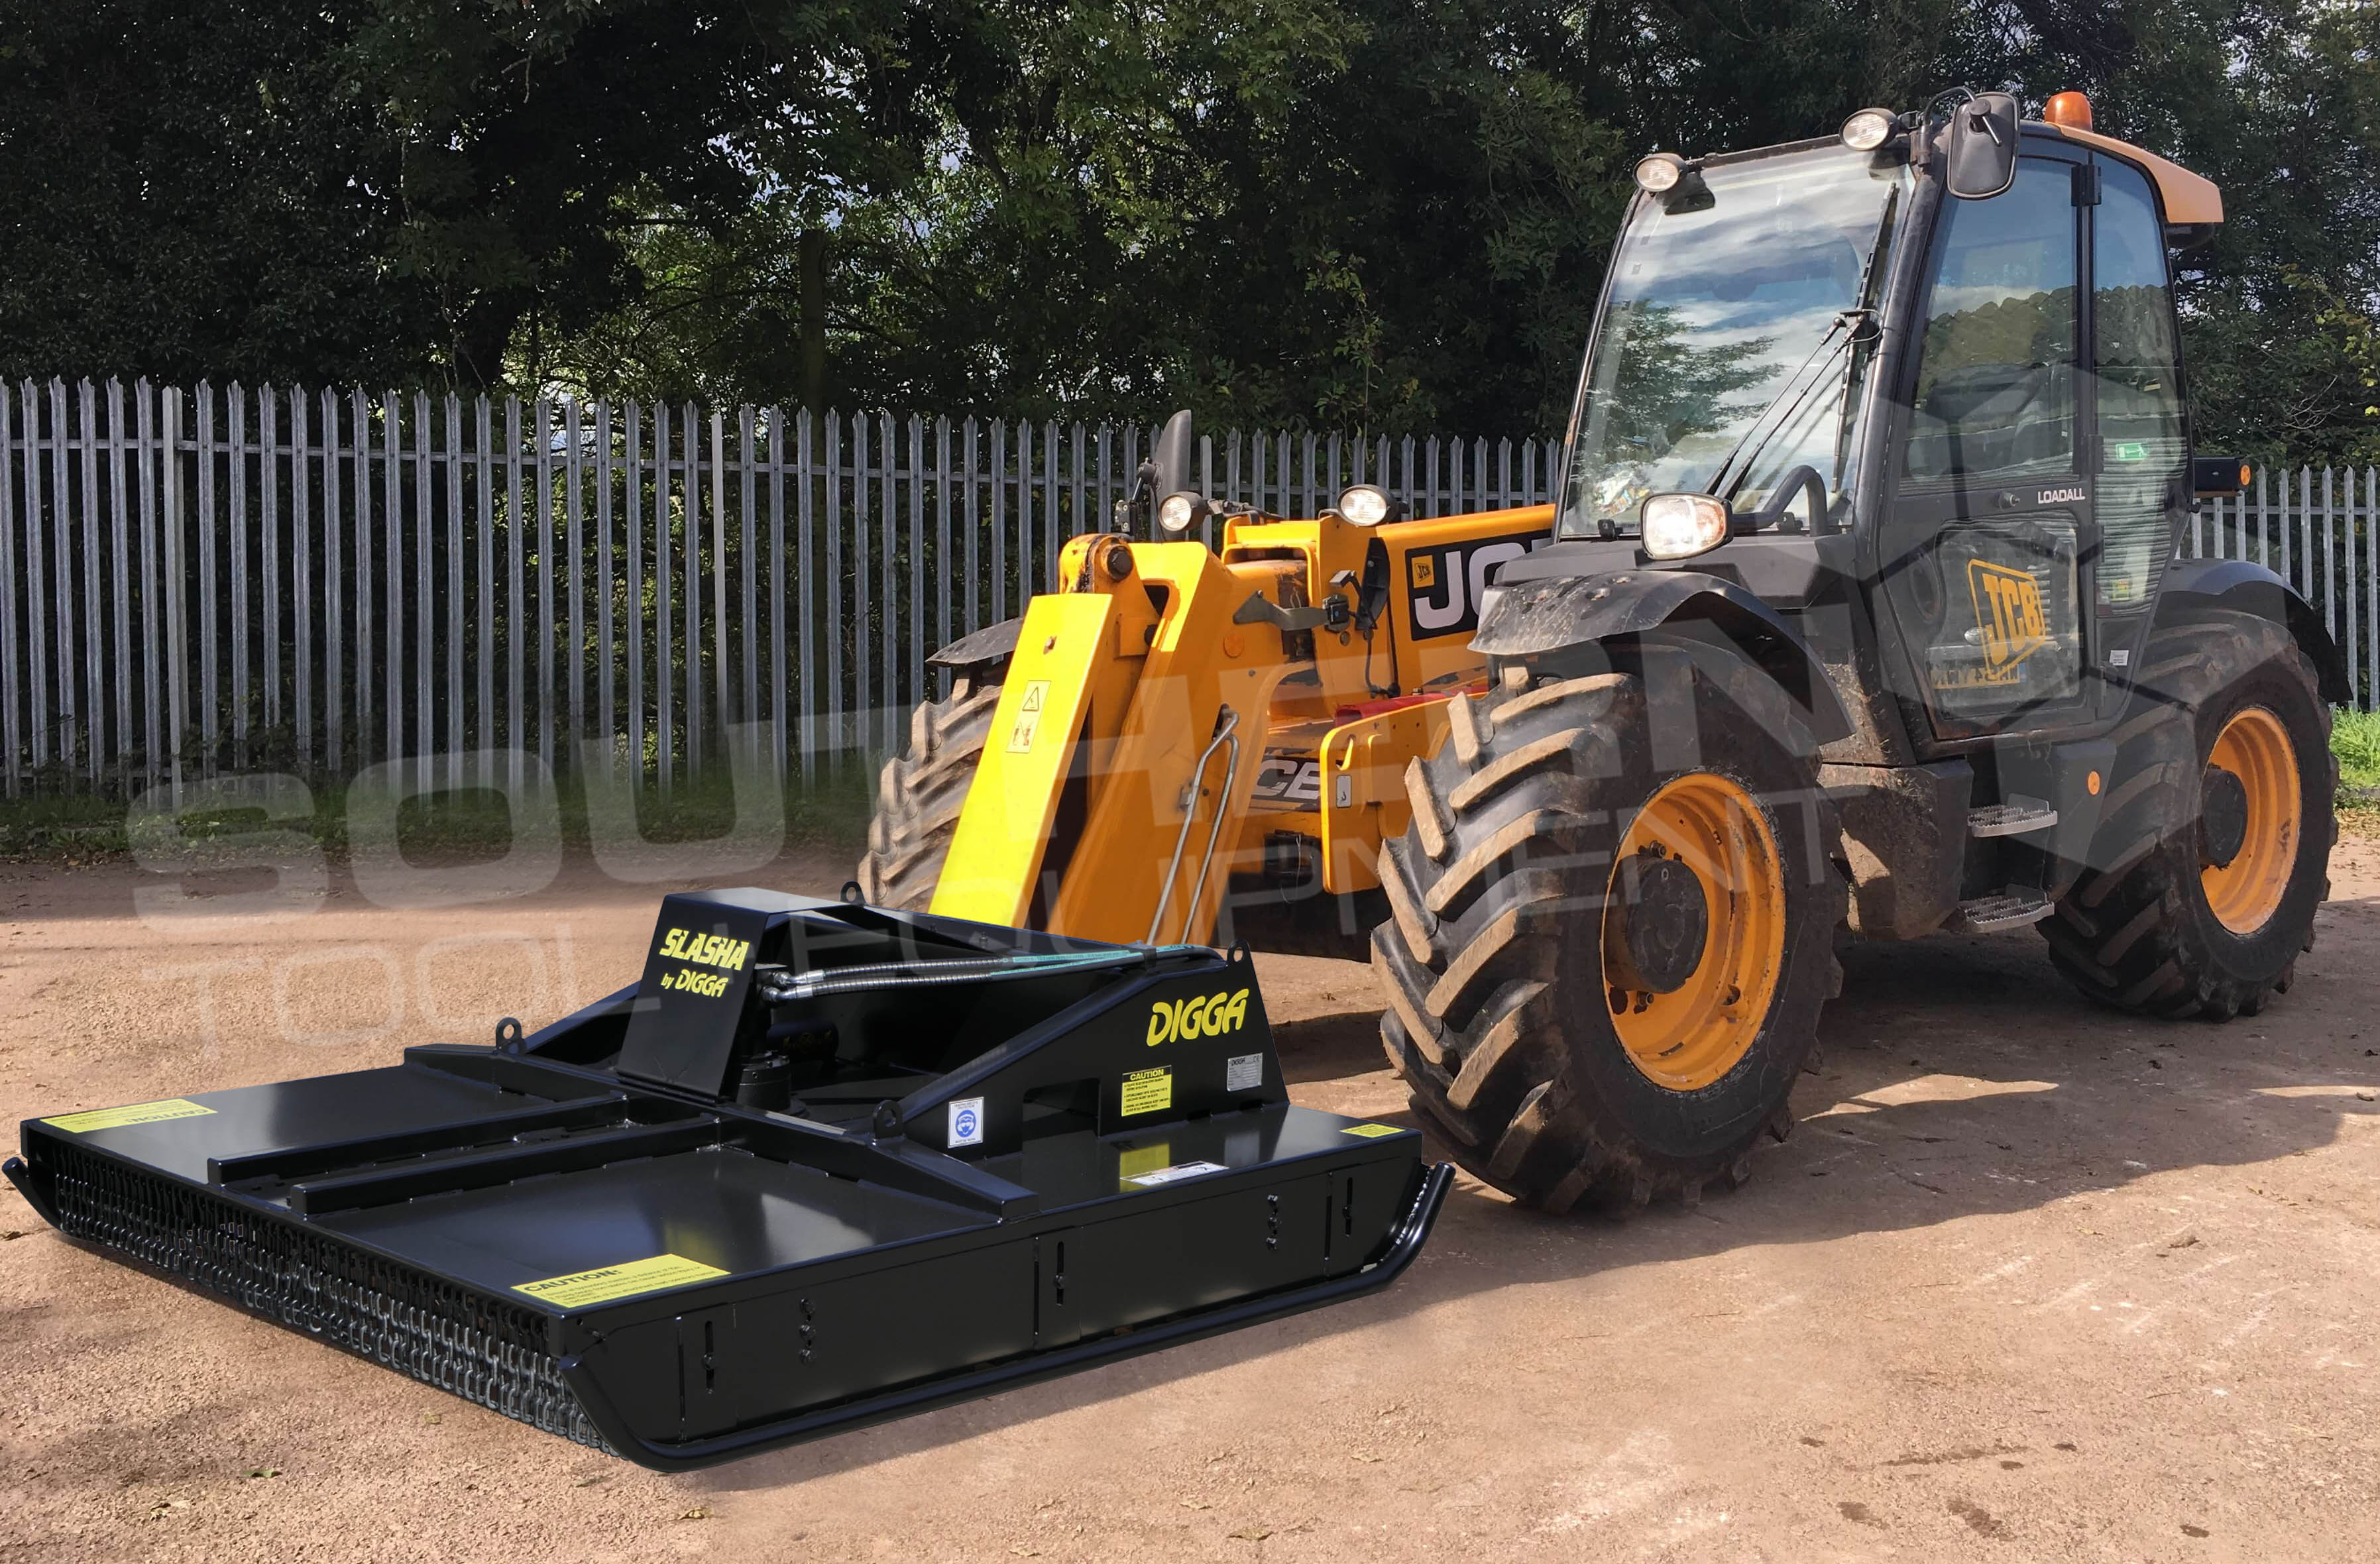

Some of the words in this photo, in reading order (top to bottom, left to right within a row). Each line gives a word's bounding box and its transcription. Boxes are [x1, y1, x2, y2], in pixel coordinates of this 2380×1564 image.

[2037, 487, 2086, 504] LOADALL
[1982, 573, 2041, 665] JCB
[659, 928, 750, 971] SLASHA
[661, 973, 674, 989] by
[675, 969, 729, 997] DIGGA
[1146, 988, 1249, 1046] DIGGA
[1130, 1068, 1164, 1081] CAUTION
[524, 1270, 622, 1292] CAUTION:
